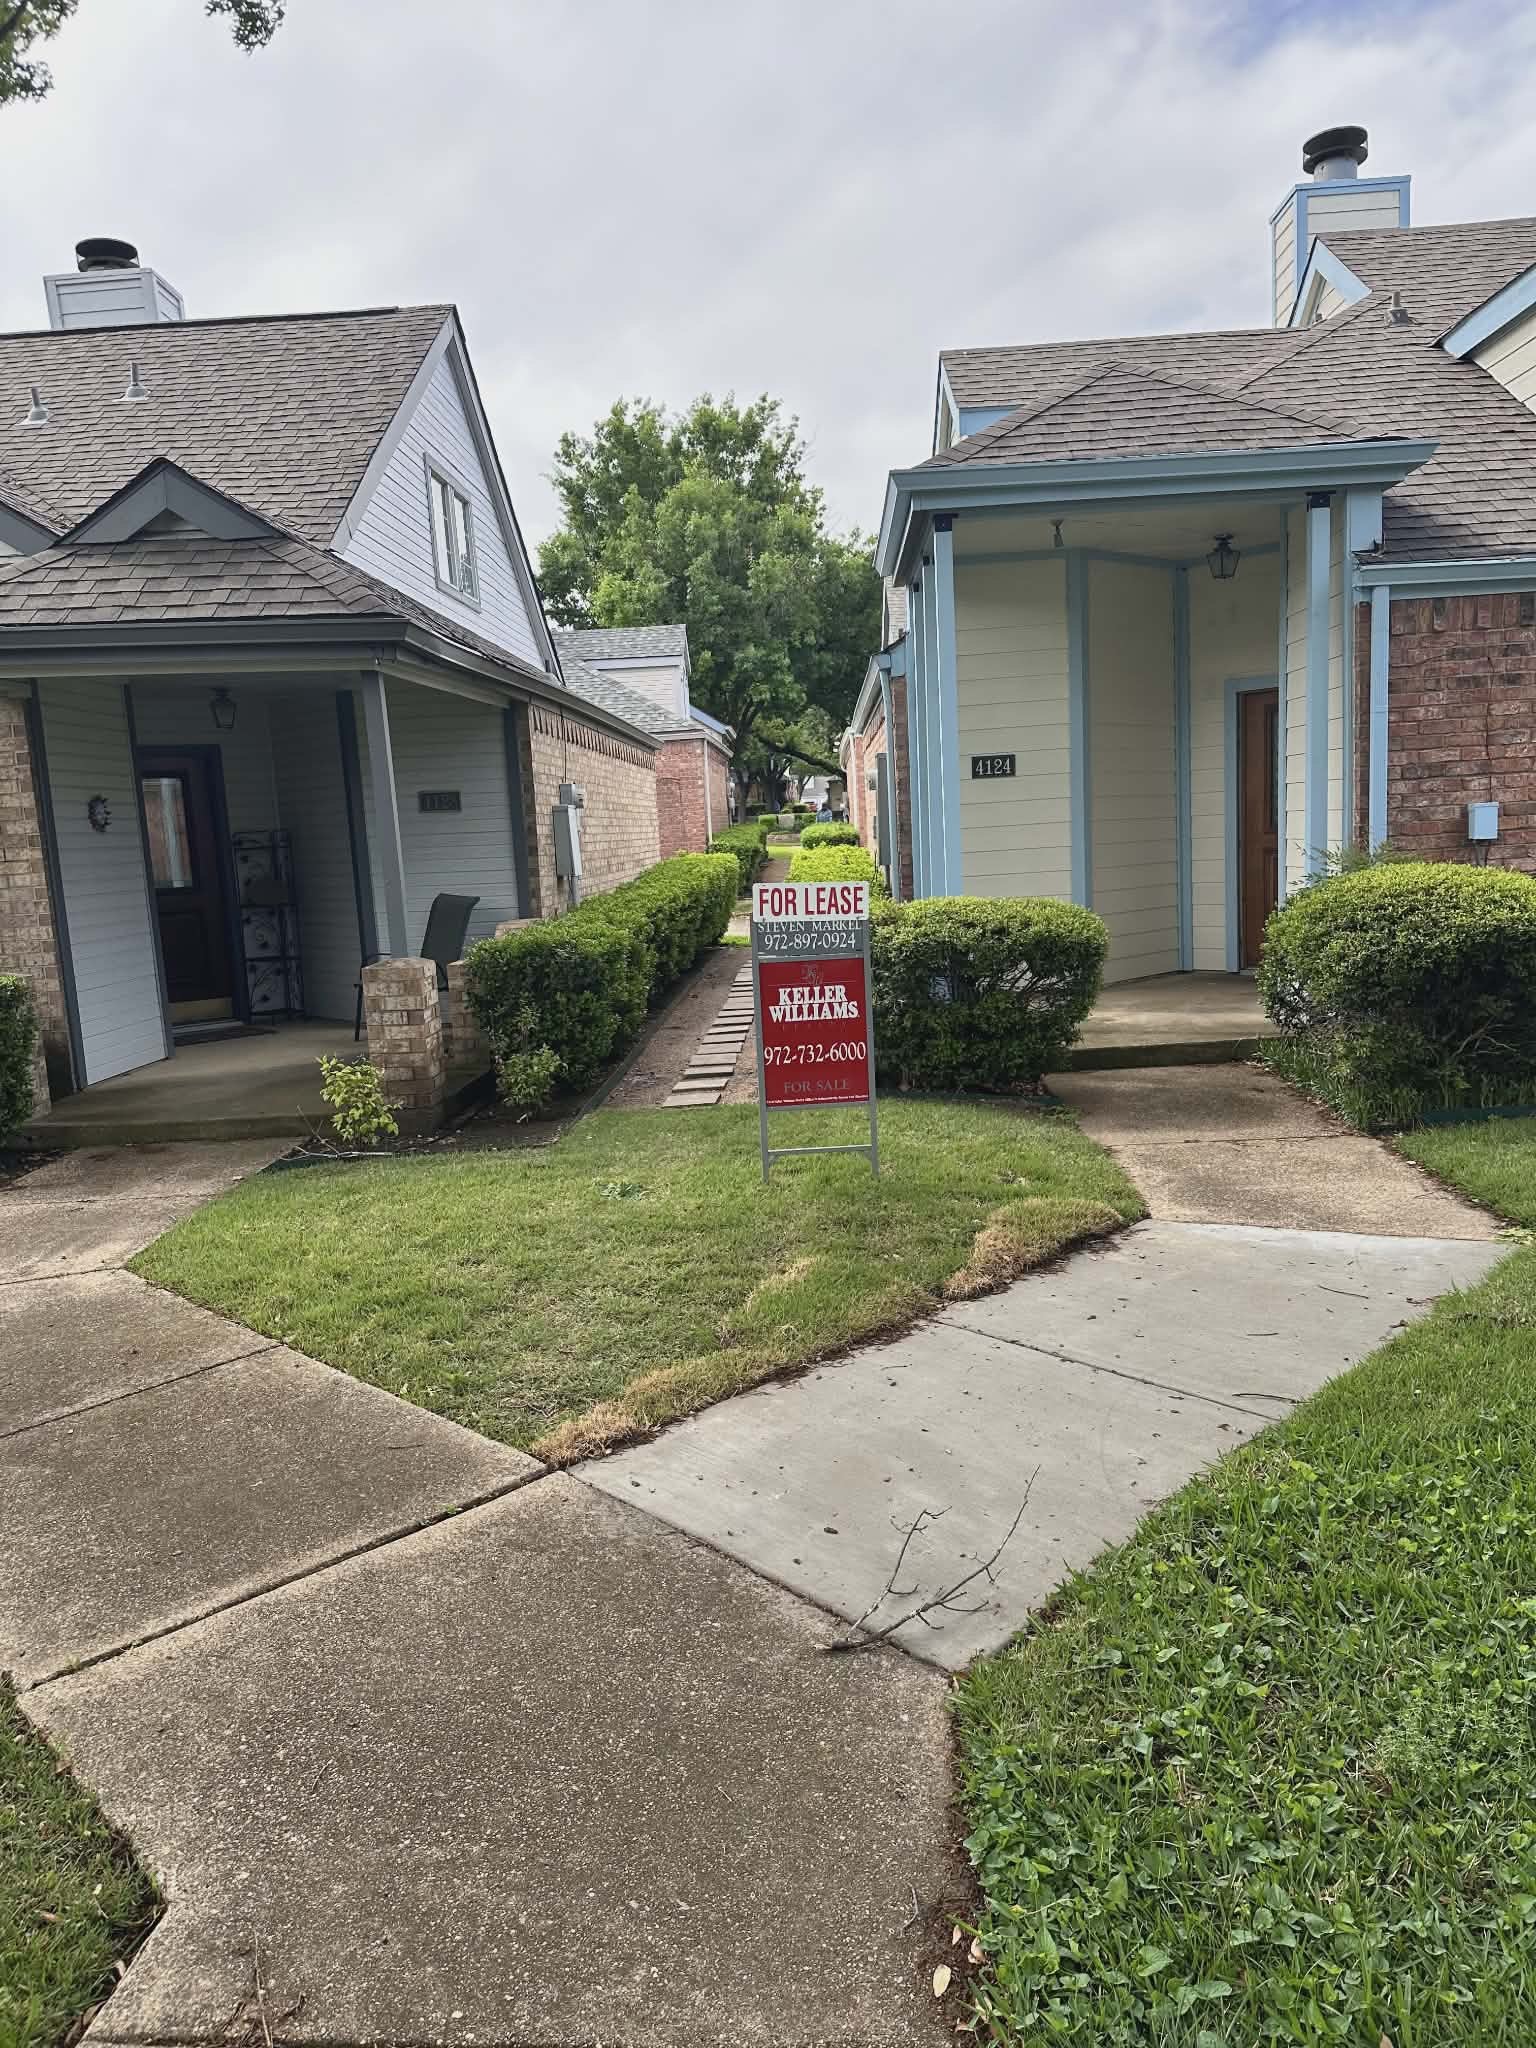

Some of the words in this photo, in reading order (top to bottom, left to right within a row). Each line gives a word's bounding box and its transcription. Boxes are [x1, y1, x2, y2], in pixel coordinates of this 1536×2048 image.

[975, 757, 1010, 776] 4124
[759, 888, 797, 916] FOR
[804, 886, 864, 915] LEASE
[758, 921, 805, 932] STEVEN
[764, 932, 856, 951] 972-897-0924
[778, 985, 848, 1006] KELLER
[768, 1001, 859, 1023] WILLIAMS
[764, 1041, 866, 1066] 972-732-6000
[783, 1080, 811, 1094] FOR
[816, 1079, 849, 1092] SALE
